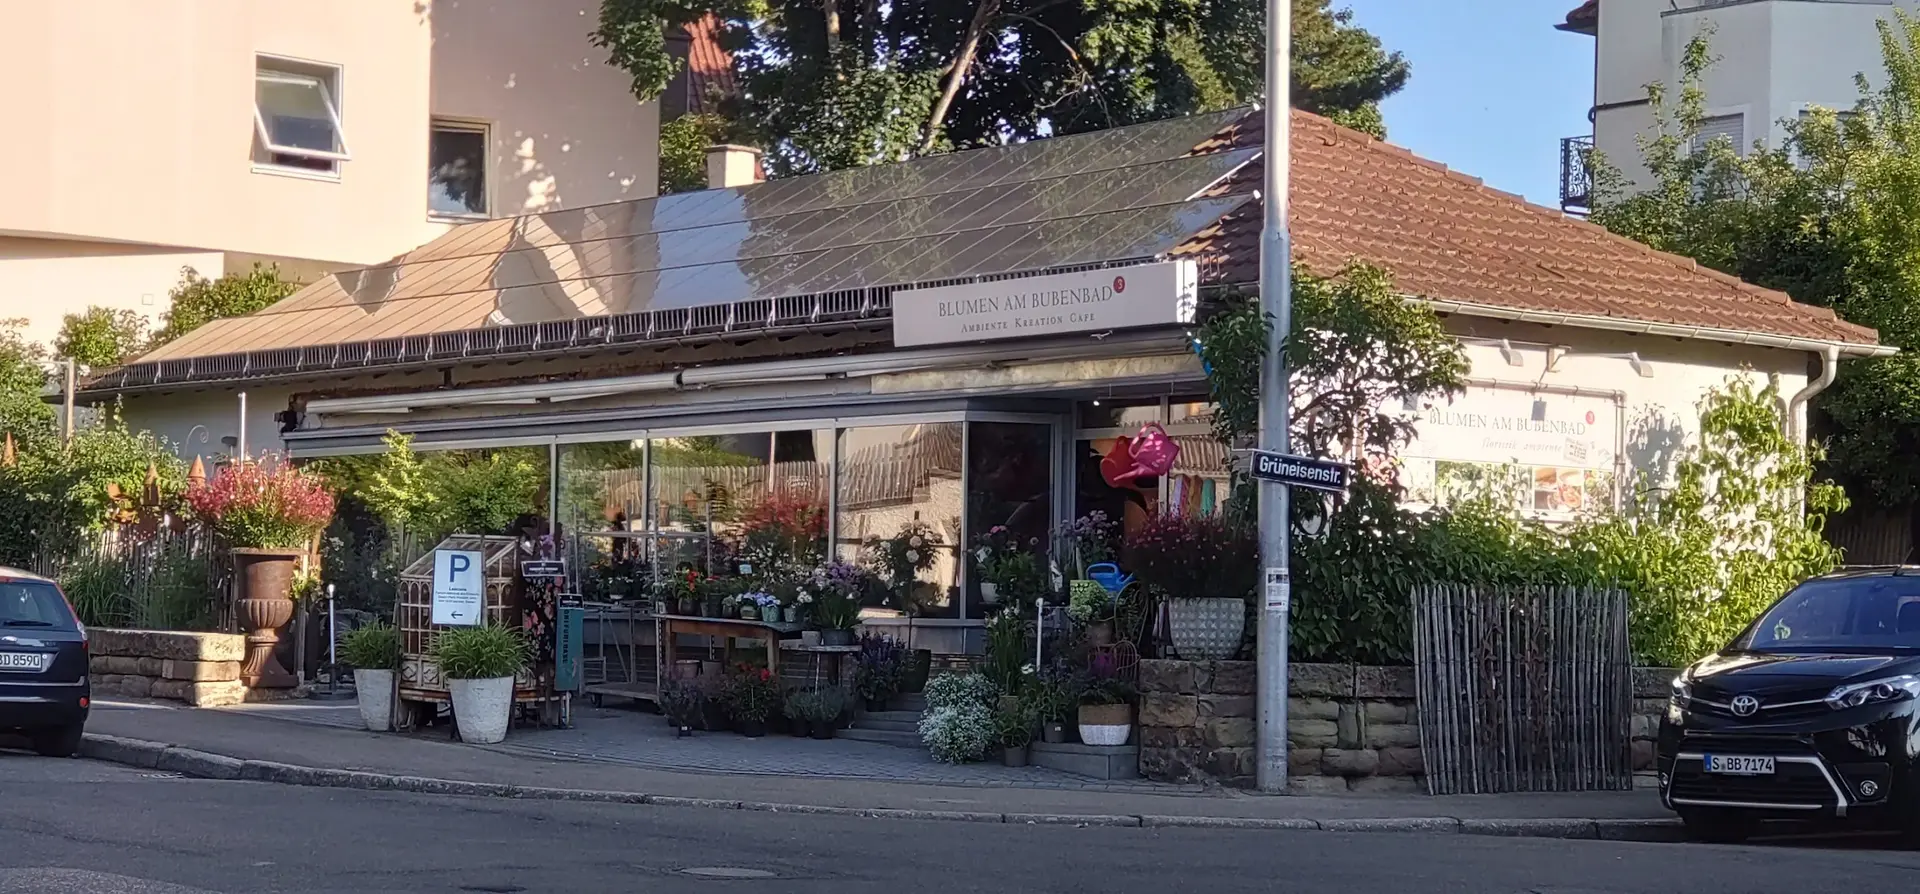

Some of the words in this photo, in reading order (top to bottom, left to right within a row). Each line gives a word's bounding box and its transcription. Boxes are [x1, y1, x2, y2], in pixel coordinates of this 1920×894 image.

[939, 296, 998, 317] BLUMEN
[1003, 294, 1026, 311] AM
[1032, 285, 1112, 308] BUBENBAD
[1429, 410, 1487, 428] BLUMEN
[1491, 416, 1512, 430] AM
[1516, 417, 1586, 435] BUBENBAD
[1259, 455, 1341, 484] Grüneisenstr.
[449, 554, 471, 583] P
[13, 654, 40, 666] 8590
[1712, 757, 1720, 770] S
[1727, 757, 1742, 771] BB
[1743, 758, 1773, 771] 7174
